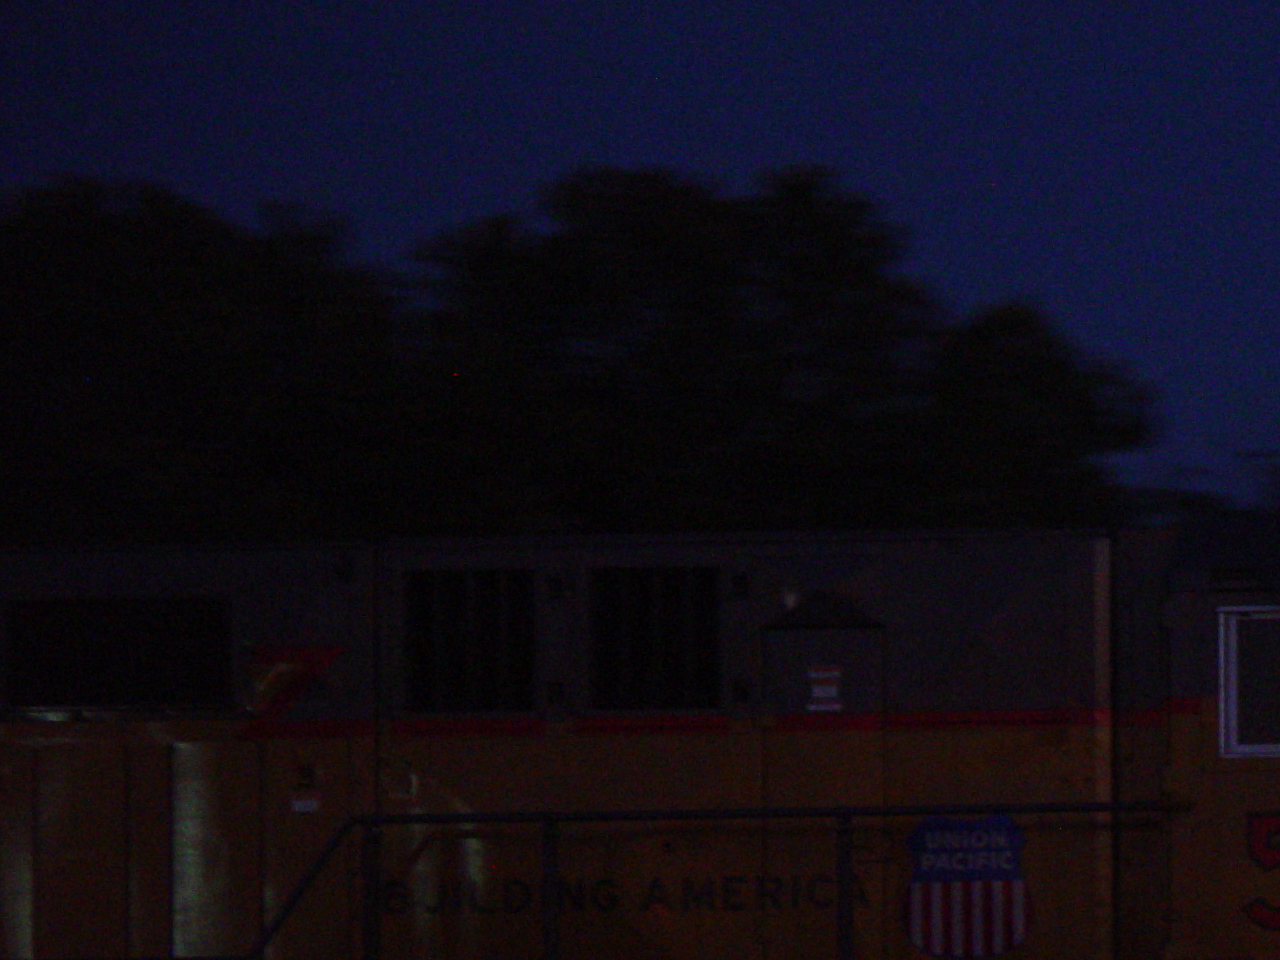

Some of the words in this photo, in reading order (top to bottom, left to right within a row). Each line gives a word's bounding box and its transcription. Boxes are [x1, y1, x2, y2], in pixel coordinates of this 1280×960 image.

[924, 830, 1012, 849] UNION
[921, 851, 1015, 870] PACIFIC
[381, 877, 619, 914] BUILDNG
